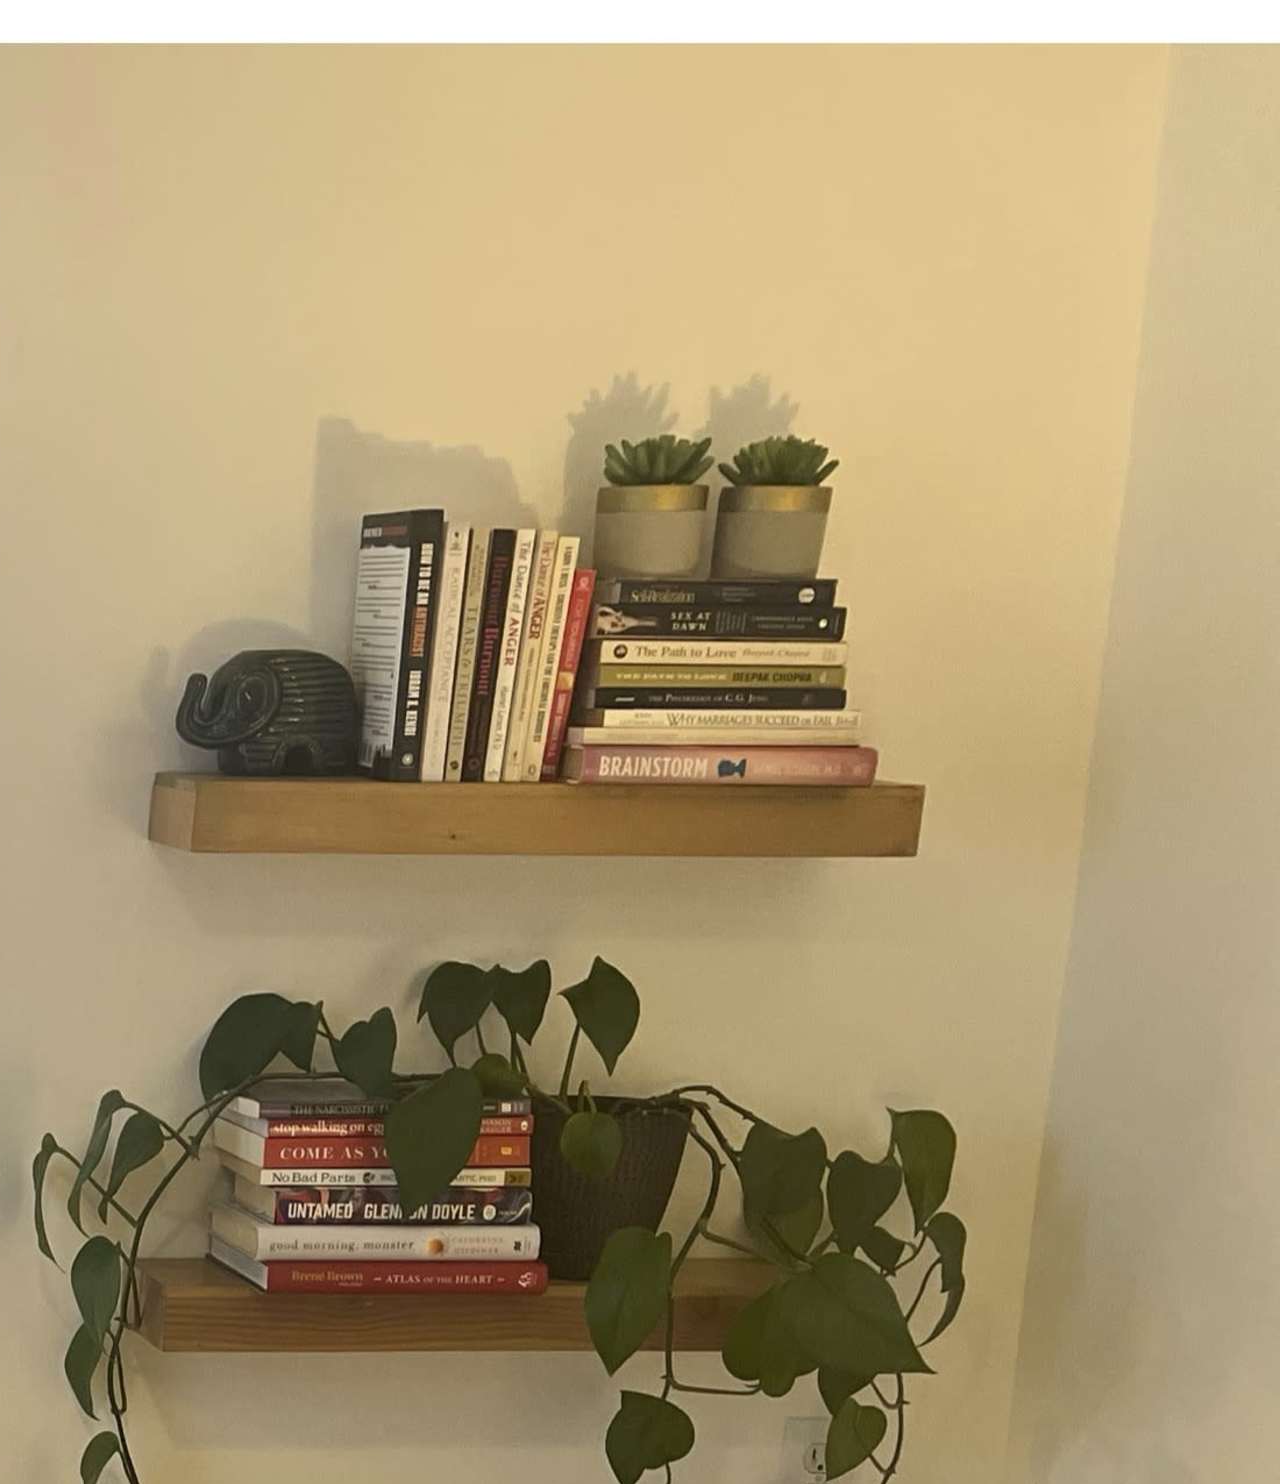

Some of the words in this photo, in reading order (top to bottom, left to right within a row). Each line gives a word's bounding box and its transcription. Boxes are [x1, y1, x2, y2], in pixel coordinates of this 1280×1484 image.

[520, 541, 532, 562] The
[513, 566, 528, 599] Dance
[528, 595, 546, 640] ANGER
[671, 611, 691, 620] SEX
[696, 611, 712, 620] AT
[463, 607, 478, 656] TEARS
[671, 621, 708, 631] DAWN
[503, 617, 520, 667] ANGER
[636, 645, 658, 658] The
[661, 646, 688, 658] Path
[690, 646, 703, 658] to
[705, 646, 737, 658] Love
[477, 627, 500, 696] Burnout
[731, 671, 770, 683] DEEPAK
[772, 672, 813, 683] CHOPRA
[452, 673, 471, 748] TRIUMPH
[667, 713, 695, 726] WHY
[696, 714, 753, 726] MARRIAGES
[755, 714, 801, 726] SUCCEED
[599, 756, 708, 778] BRAINSTORM
[269, 1120, 297, 1136] stop
[297, 1119, 349, 1137] walking
[351, 1123, 365, 1134] on
[280, 1147, 334, 1160] COME
[343, 1147, 365, 1160] AS
[271, 1171, 291, 1183] No
[291, 1171, 319, 1183] Bad
[320, 1172, 356, 1183] Parts
[288, 1203, 353, 1219] UNTAMED
[364, 1203, 428, 1220] GLENN
[432, 1204, 476, 1220] DOYLE
[269, 1239, 298, 1252] good
[363, 1240, 415, 1250] monster
[326, 1271, 363, 1282] Brown
[385, 1274, 421, 1284] ATLAS
[454, 1274, 493, 1284] HEART
